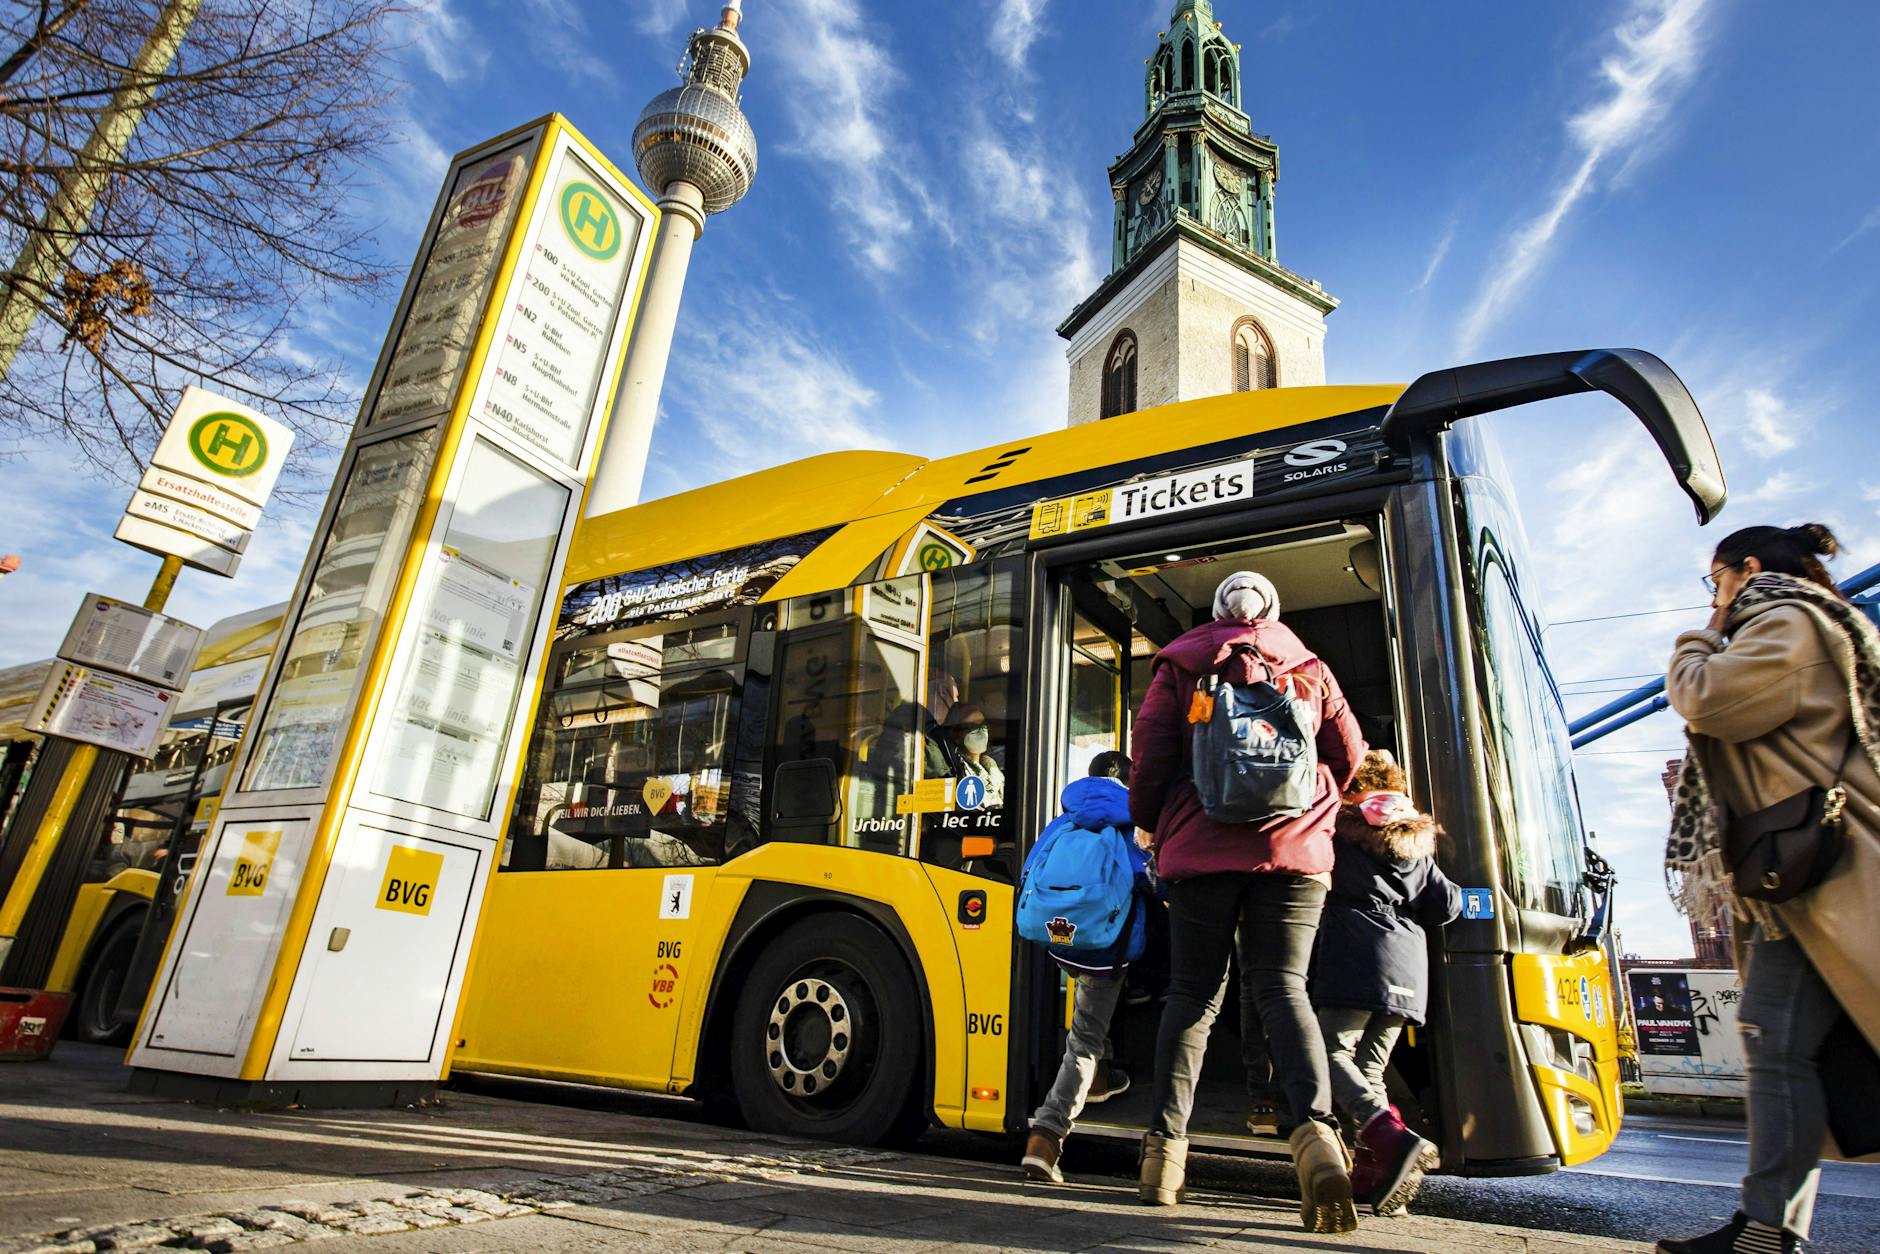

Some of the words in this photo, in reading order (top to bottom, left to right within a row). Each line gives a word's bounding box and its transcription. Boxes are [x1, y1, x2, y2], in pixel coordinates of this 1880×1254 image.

[575, 196, 610, 248] H
[543, 248, 558, 265] 100
[592, 289, 613, 308] Garten
[560, 272, 569, 283] via
[570, 279, 599, 307] Reichstag
[523, 307, 538, 324] N2
[544, 322, 563, 339] U-Bhf
[532, 277, 550, 296] 200
[583, 316, 603, 336] Garten
[557, 304, 589, 334] Potsdamer
[513, 338, 527, 354] N5
[534, 352, 562, 376] S+U-Bhf
[541, 330, 571, 356] Ruhleben
[503, 370, 518, 386] N8
[525, 384, 553, 408] S+U-Bhf
[531, 361, 578, 396] Hauptbahnhof
[492, 403, 513, 423] N40
[514, 417, 549, 444] Karlshorst
[522, 393, 571, 430] Hermannstraße
[208, 423, 252, 465] H
[1283, 462, 1348, 483] SOLARIS
[156, 477, 248, 519] Ersatzhaltestelle
[1121, 471, 1244, 517] Tickets
[586, 591, 623, 626] 200
[646, 575, 711, 601] Zoologischer
[650, 788, 665, 799] BVG
[558, 808, 571, 819] EIL
[573, 807, 588, 818] WIR
[590, 806, 609, 817] DICH
[611, 804, 642, 816] LIEBEN.
[852, 816, 906, 832] Urbino
[232, 863, 268, 888] BVG
[385, 878, 430, 908] BVG
[657, 941, 682, 958] BVG
[652, 979, 675, 993] VBB
[967, 1012, 1004, 1036] BVG
[1637, 1019, 1658, 1028] PAUL
[1656, 1019, 1675, 1028] VAN
[1674, 1020, 1692, 1028] DYK
